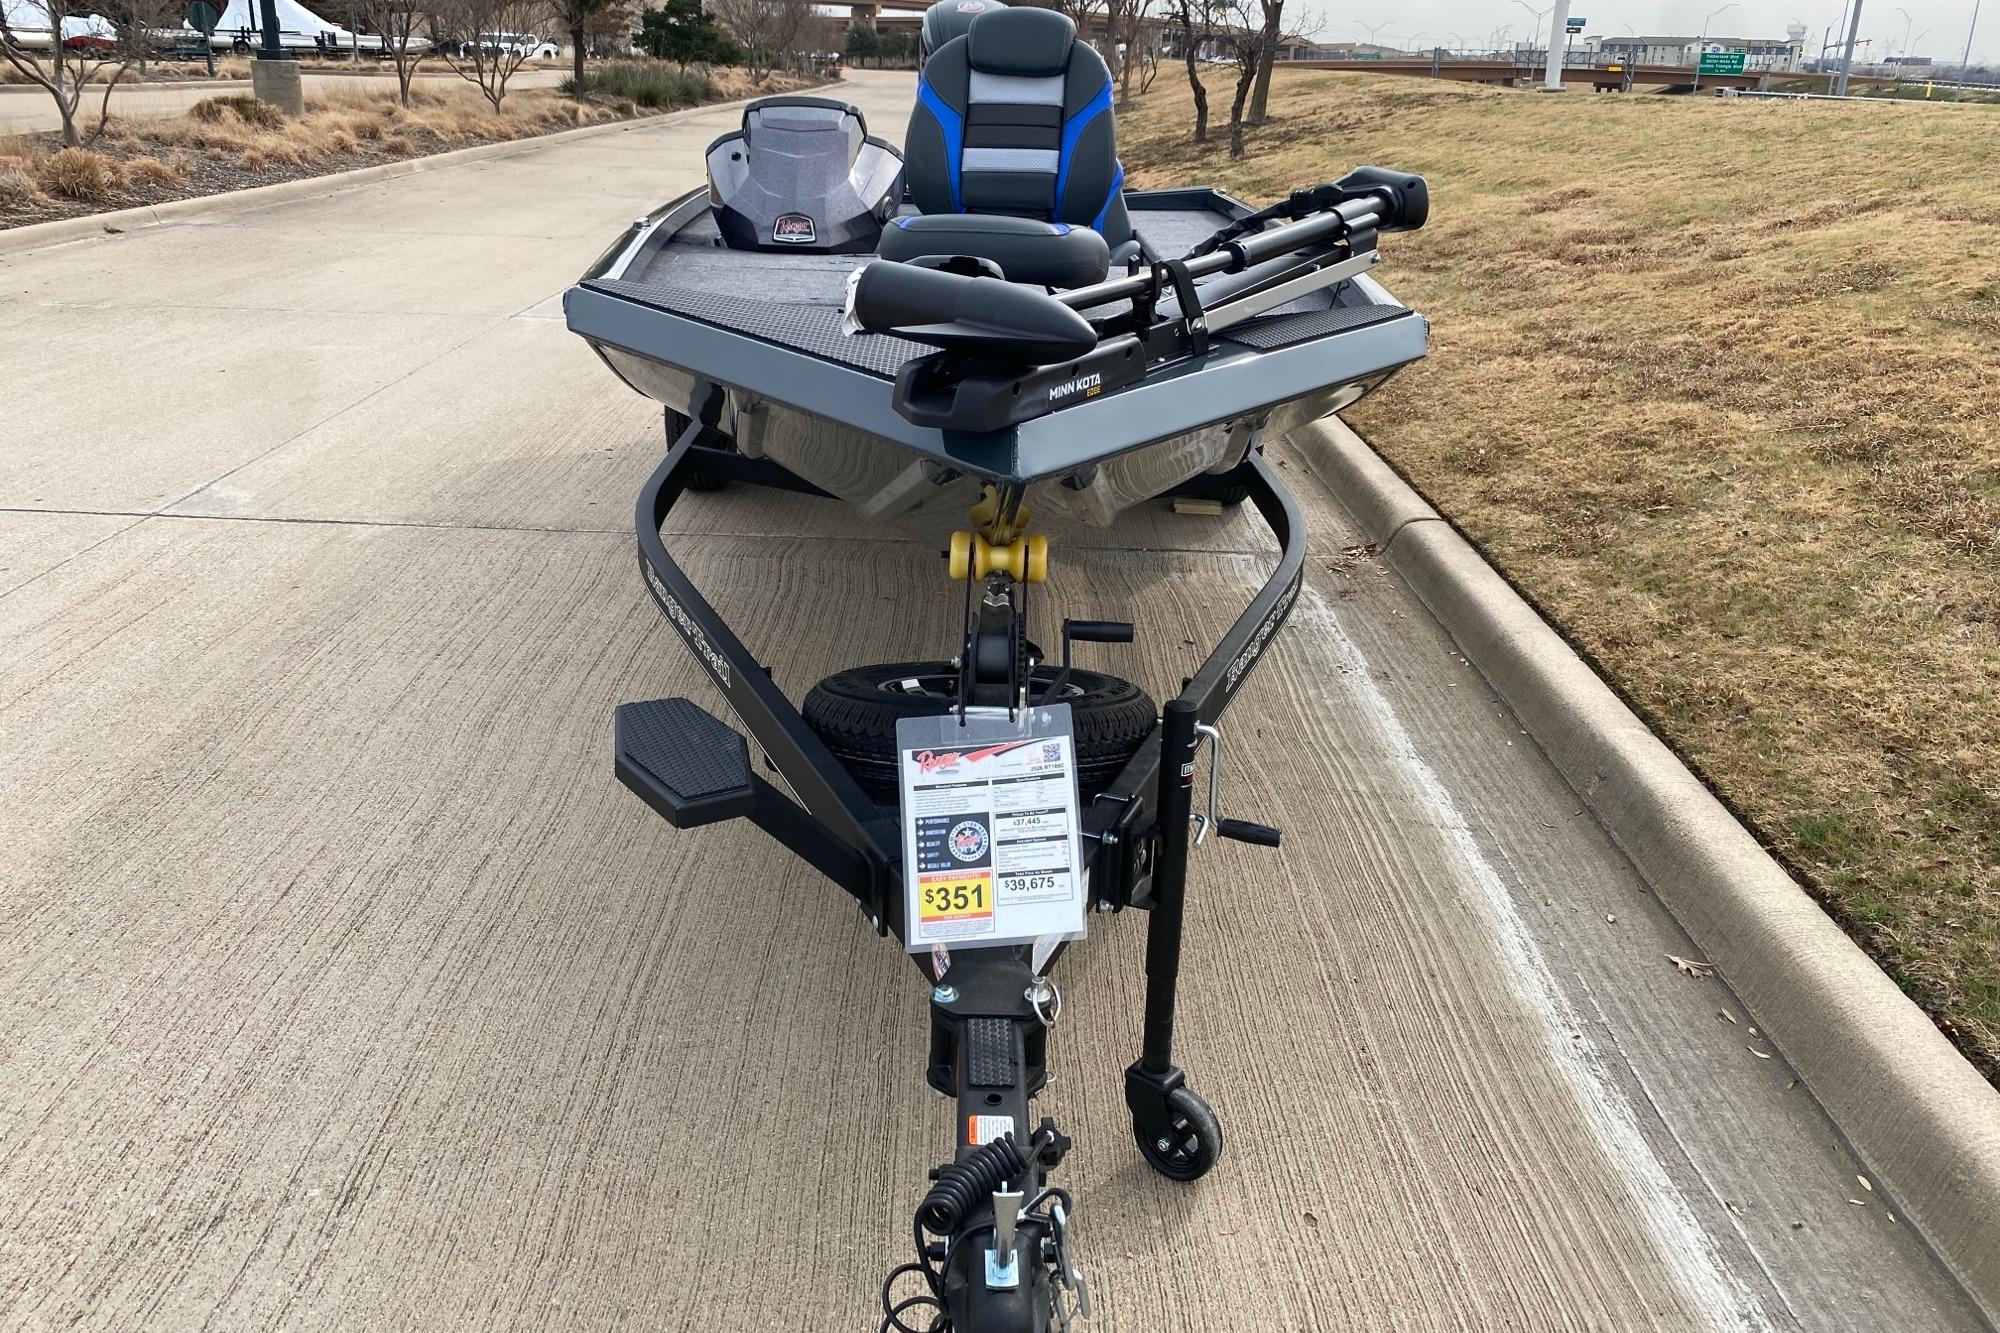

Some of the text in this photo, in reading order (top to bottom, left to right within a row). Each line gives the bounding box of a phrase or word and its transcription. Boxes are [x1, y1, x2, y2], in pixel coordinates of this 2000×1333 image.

[1049, 372, 1101, 401] MINN KOTA
[1086, 385, 1101, 398] EDGE
[1225, 610, 1276, 693] Ranger
[917, 750, 961, 775] Ranger
[1005, 876, 1055, 892] $39,675
[925, 884, 983, 911] $351
